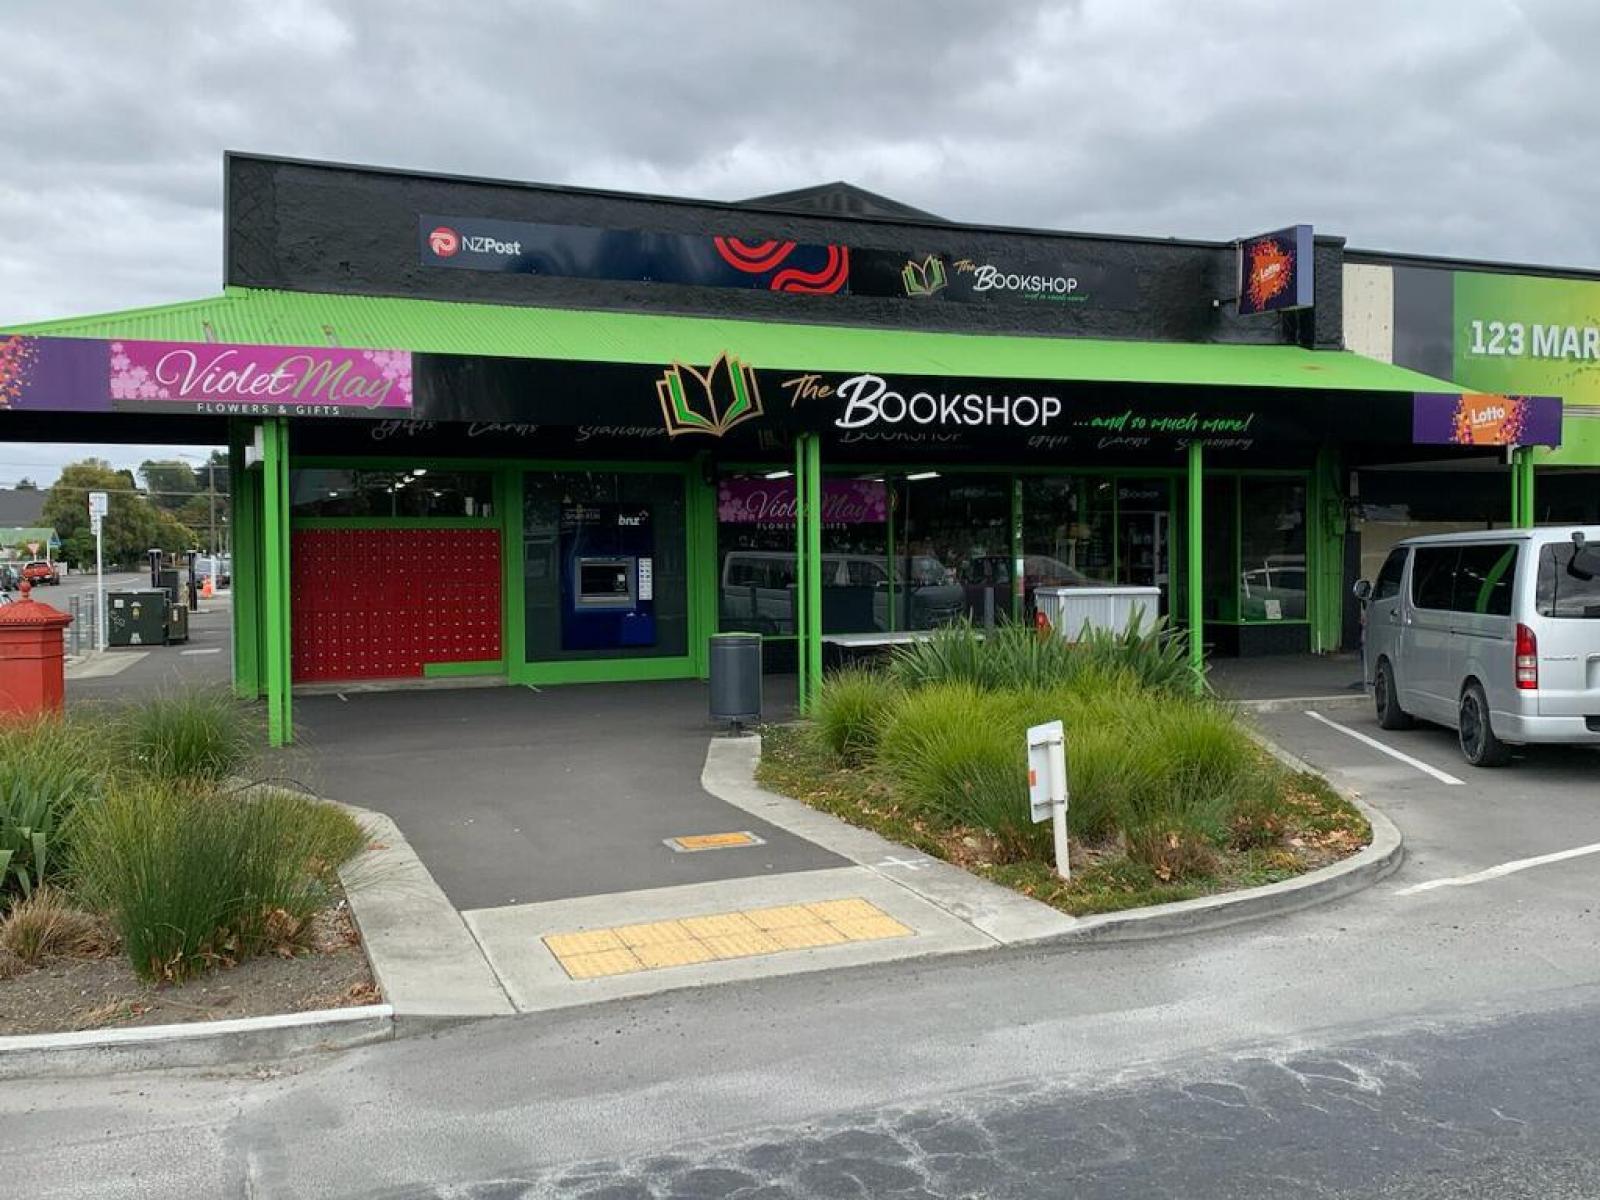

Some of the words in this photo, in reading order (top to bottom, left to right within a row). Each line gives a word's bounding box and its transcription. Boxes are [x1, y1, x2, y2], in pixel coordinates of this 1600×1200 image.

[462, 235, 521, 255] NZPost
[973, 264, 1078, 293] BOOKSHOP
[1260, 263, 1281, 279] Lotto
[1471, 320, 1525, 356] 123
[1532, 324, 1600, 359] MAR
[155, 349, 296, 396] Violet
[277, 355, 396, 410] May
[197, 402, 270, 414] FLOWERS
[278, 403, 287, 415] &
[296, 403, 340, 415] GIFTS
[781, 374, 836, 409] The
[834, 373, 1062, 429] BOOKSHOP
[1131, 417, 1146, 429] so
[1151, 411, 1198, 431] much
[1202, 412, 1255, 432] more!
[1471, 405, 1506, 425] Lotto
